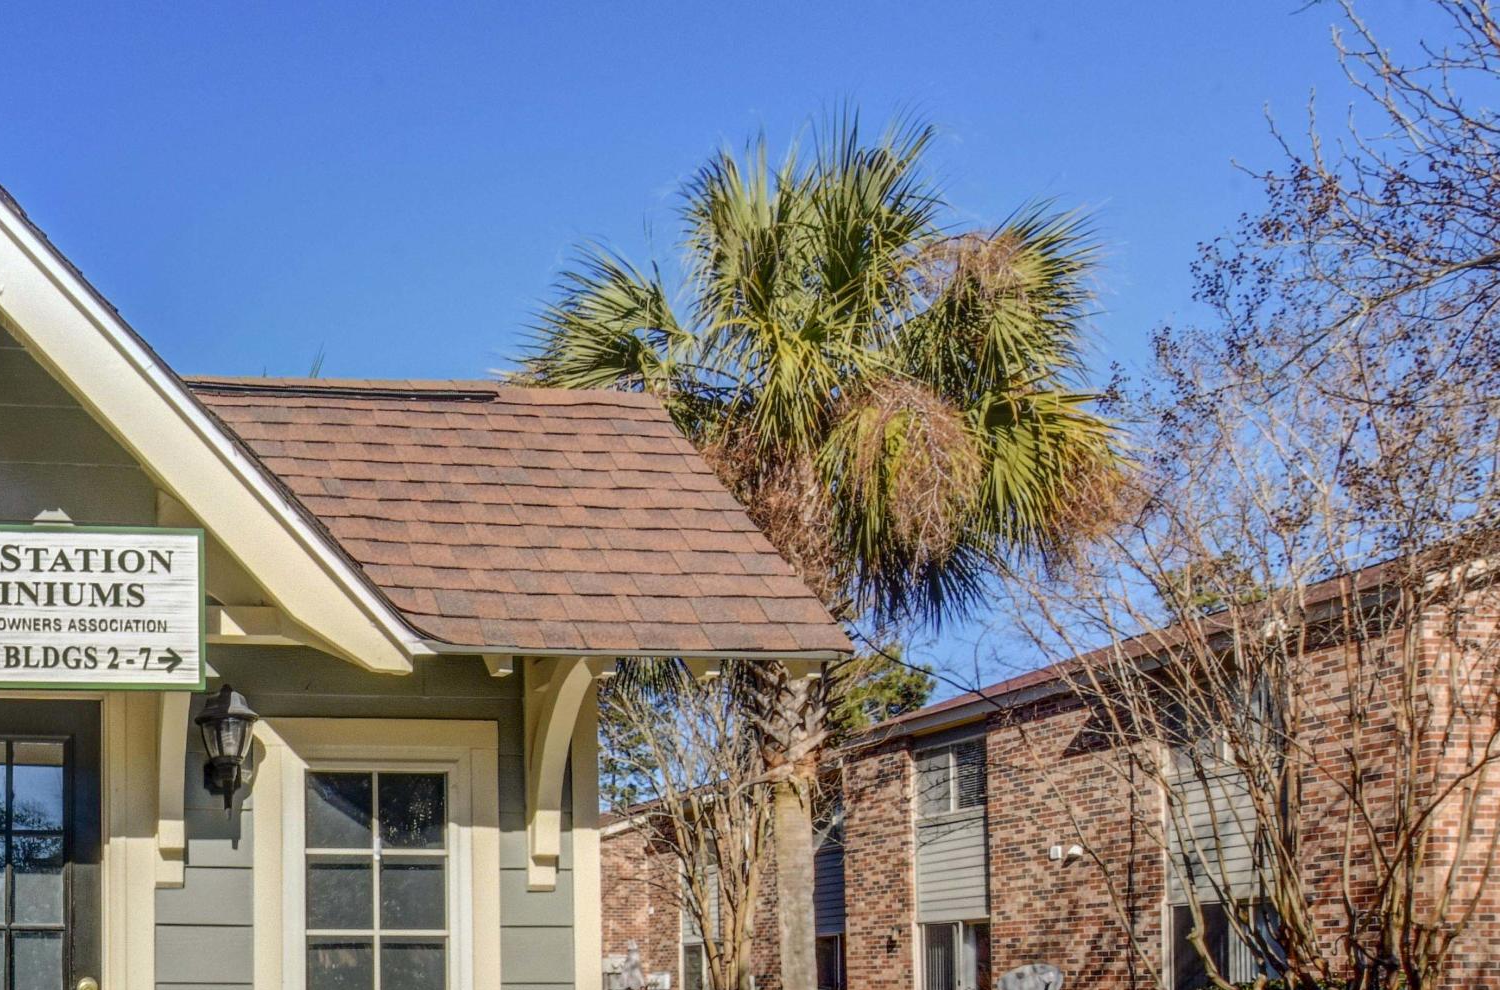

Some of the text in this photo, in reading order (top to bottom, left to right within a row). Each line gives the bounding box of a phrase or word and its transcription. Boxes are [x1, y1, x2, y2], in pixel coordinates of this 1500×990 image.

[0, 544, 175, 573] STATION
[67, 618, 168, 633] ASSOCIATION
[4, 646, 98, 670] BLDGS
